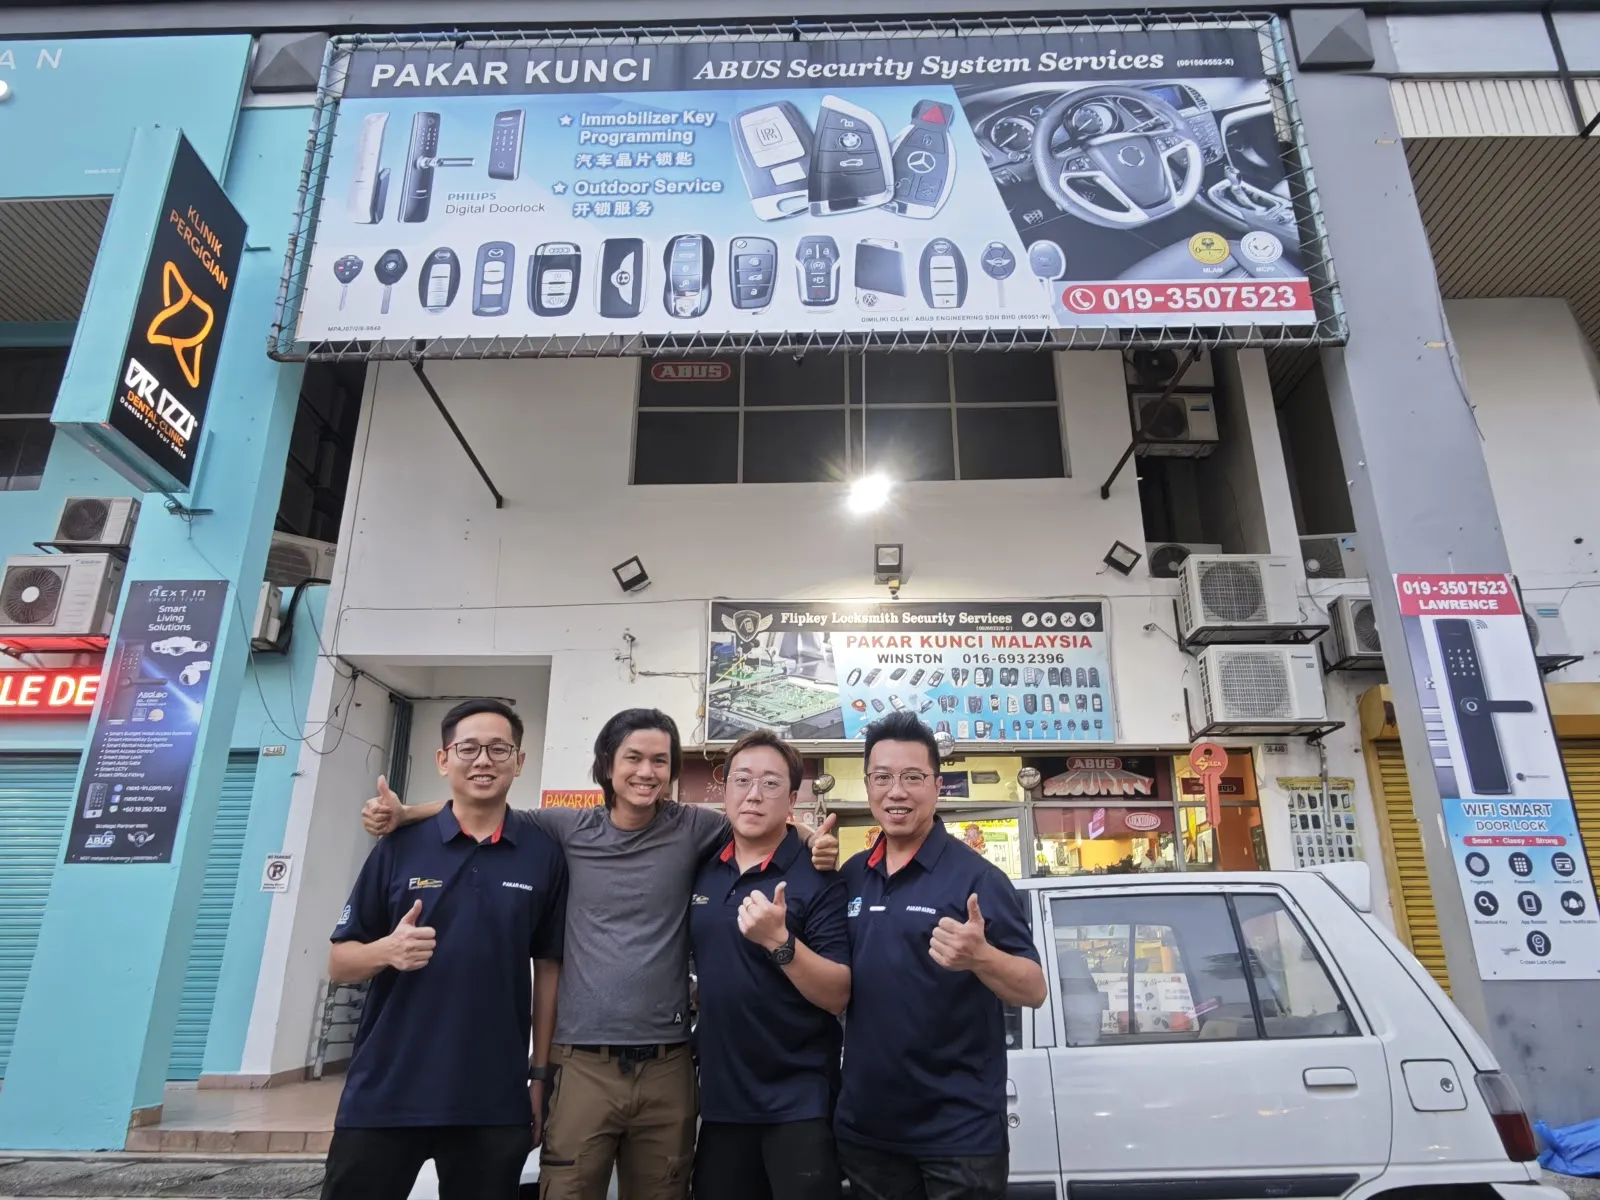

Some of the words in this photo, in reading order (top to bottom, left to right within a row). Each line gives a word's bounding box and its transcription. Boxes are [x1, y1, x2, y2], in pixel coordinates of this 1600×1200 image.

[371, 61, 508, 88] PAKAR
[525, 57, 650, 85] KUNCI
[693, 60, 781, 80] ABUS
[787, 55, 913, 81] Security
[921, 54, 1031, 80] System
[1038, 49, 1164, 72] Services
[581, 111, 679, 126] Immobilizer
[683, 110, 716, 126] Key
[580, 129, 693, 147] Programming
[575, 152, 693, 168] 汽车晶片锁匙
[574, 180, 649, 195] Outdoor
[654, 178, 722, 194] Service
[447, 191, 497, 200] PHILIPS
[445, 203, 485, 216] Digital
[489, 201, 546, 213] Doorlock
[573, 201, 653, 217] 开锁服务
[187, 204, 223, 258] KLINIK
[170, 208, 228, 290] PERGIGIAN
[1103, 286, 1297, 310] 019-3507523
[660, 365, 722, 378] ABUS
[127, 390, 159, 424] DENTAL
[159, 419, 185, 447] CLINIC
[1402, 581, 1508, 595] 019-3507523
[158, 605, 187, 613] Smart
[1419, 599, 1499, 610] LAWRENCE
[156, 614, 184, 624] Living
[781, 611, 829, 627] Flipkey
[832, 611, 899, 625] Locksmith
[902, 611, 956, 627] Security
[959, 611, 1013, 625] Services
[148, 623, 192, 631] Solutions
[846, 635, 913, 649] PAKAR
[920, 634, 984, 648] KUNCI
[991, 634, 1093, 648] MALAYSIA
[877, 653, 944, 665] WINSTON
[1073, 758, 1116, 769] ABUS
[545, 793, 583, 808] PAKAR
[1462, 803, 1496, 817] WIFI
[1500, 803, 1552, 817] SMART
[1476, 821, 1510, 831] DOOR
[1513, 821, 1547, 831] LOCK
[86, 836, 113, 845] ABUS
[1536, 838, 1559, 846] Strong
